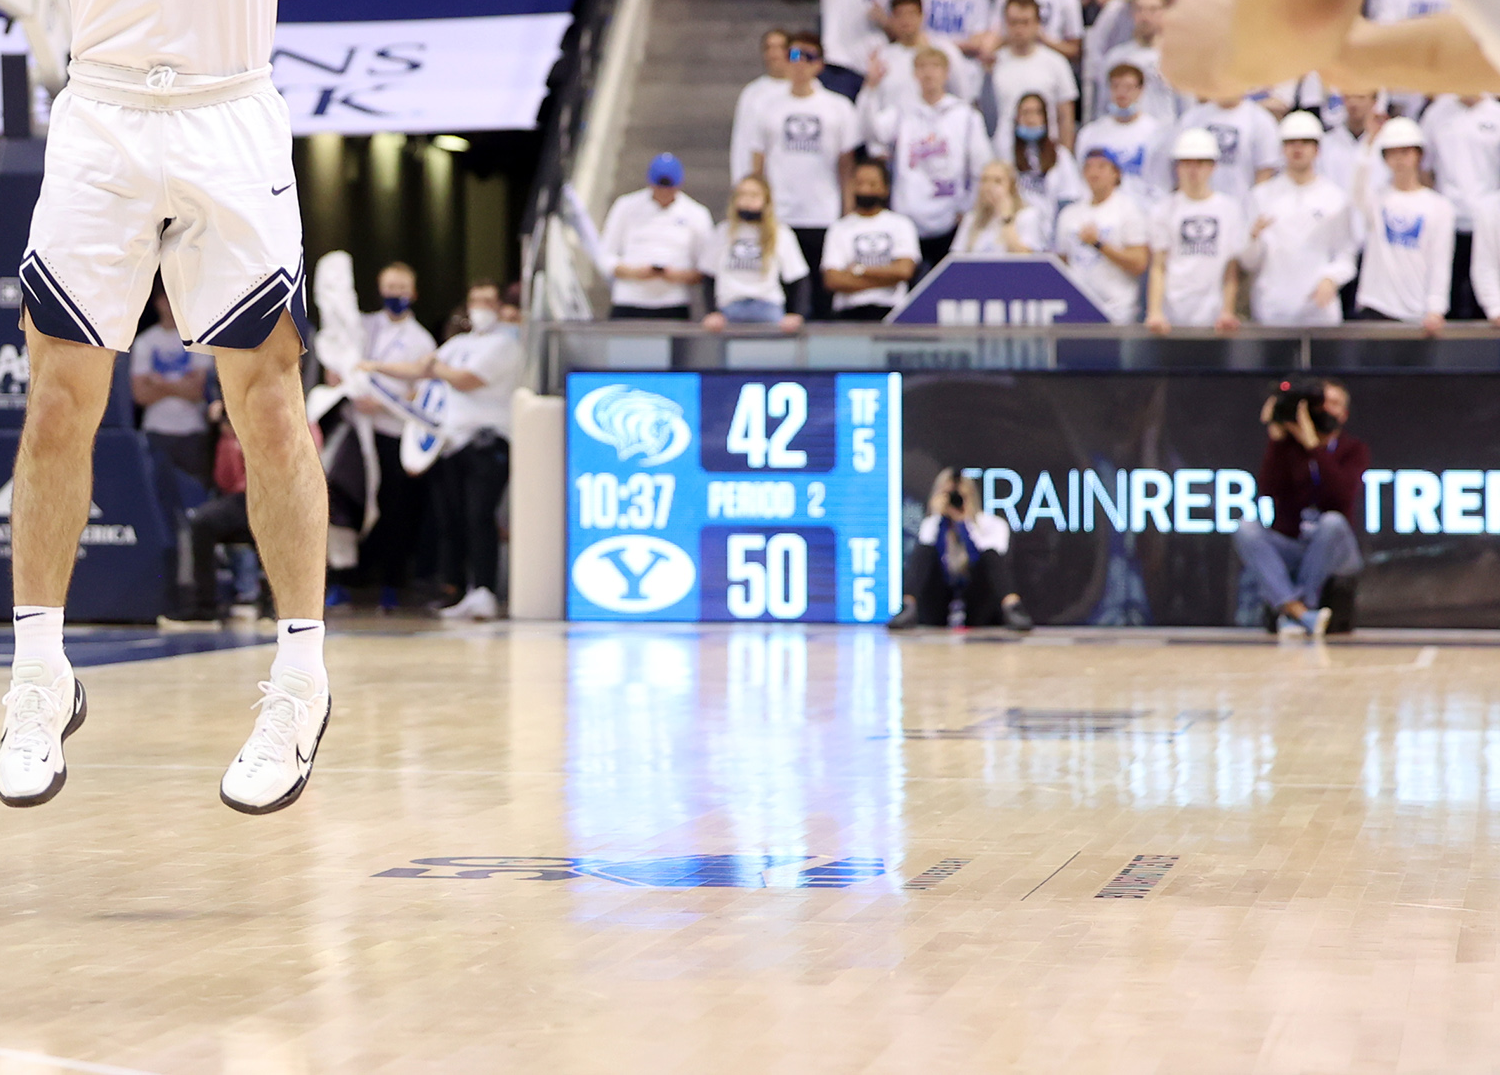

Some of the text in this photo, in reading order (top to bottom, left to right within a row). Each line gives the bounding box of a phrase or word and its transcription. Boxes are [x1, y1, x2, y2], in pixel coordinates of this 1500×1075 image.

[726, 382, 808, 469] 42
[848, 388, 881, 427] TF
[852, 427, 877, 473] 5
[575, 472, 676, 530] 10:37
[706, 481, 827, 519] PERIOD 2
[726, 533, 808, 620] 50
[848, 537, 881, 575] TF
[852, 577, 877, 623] 5
